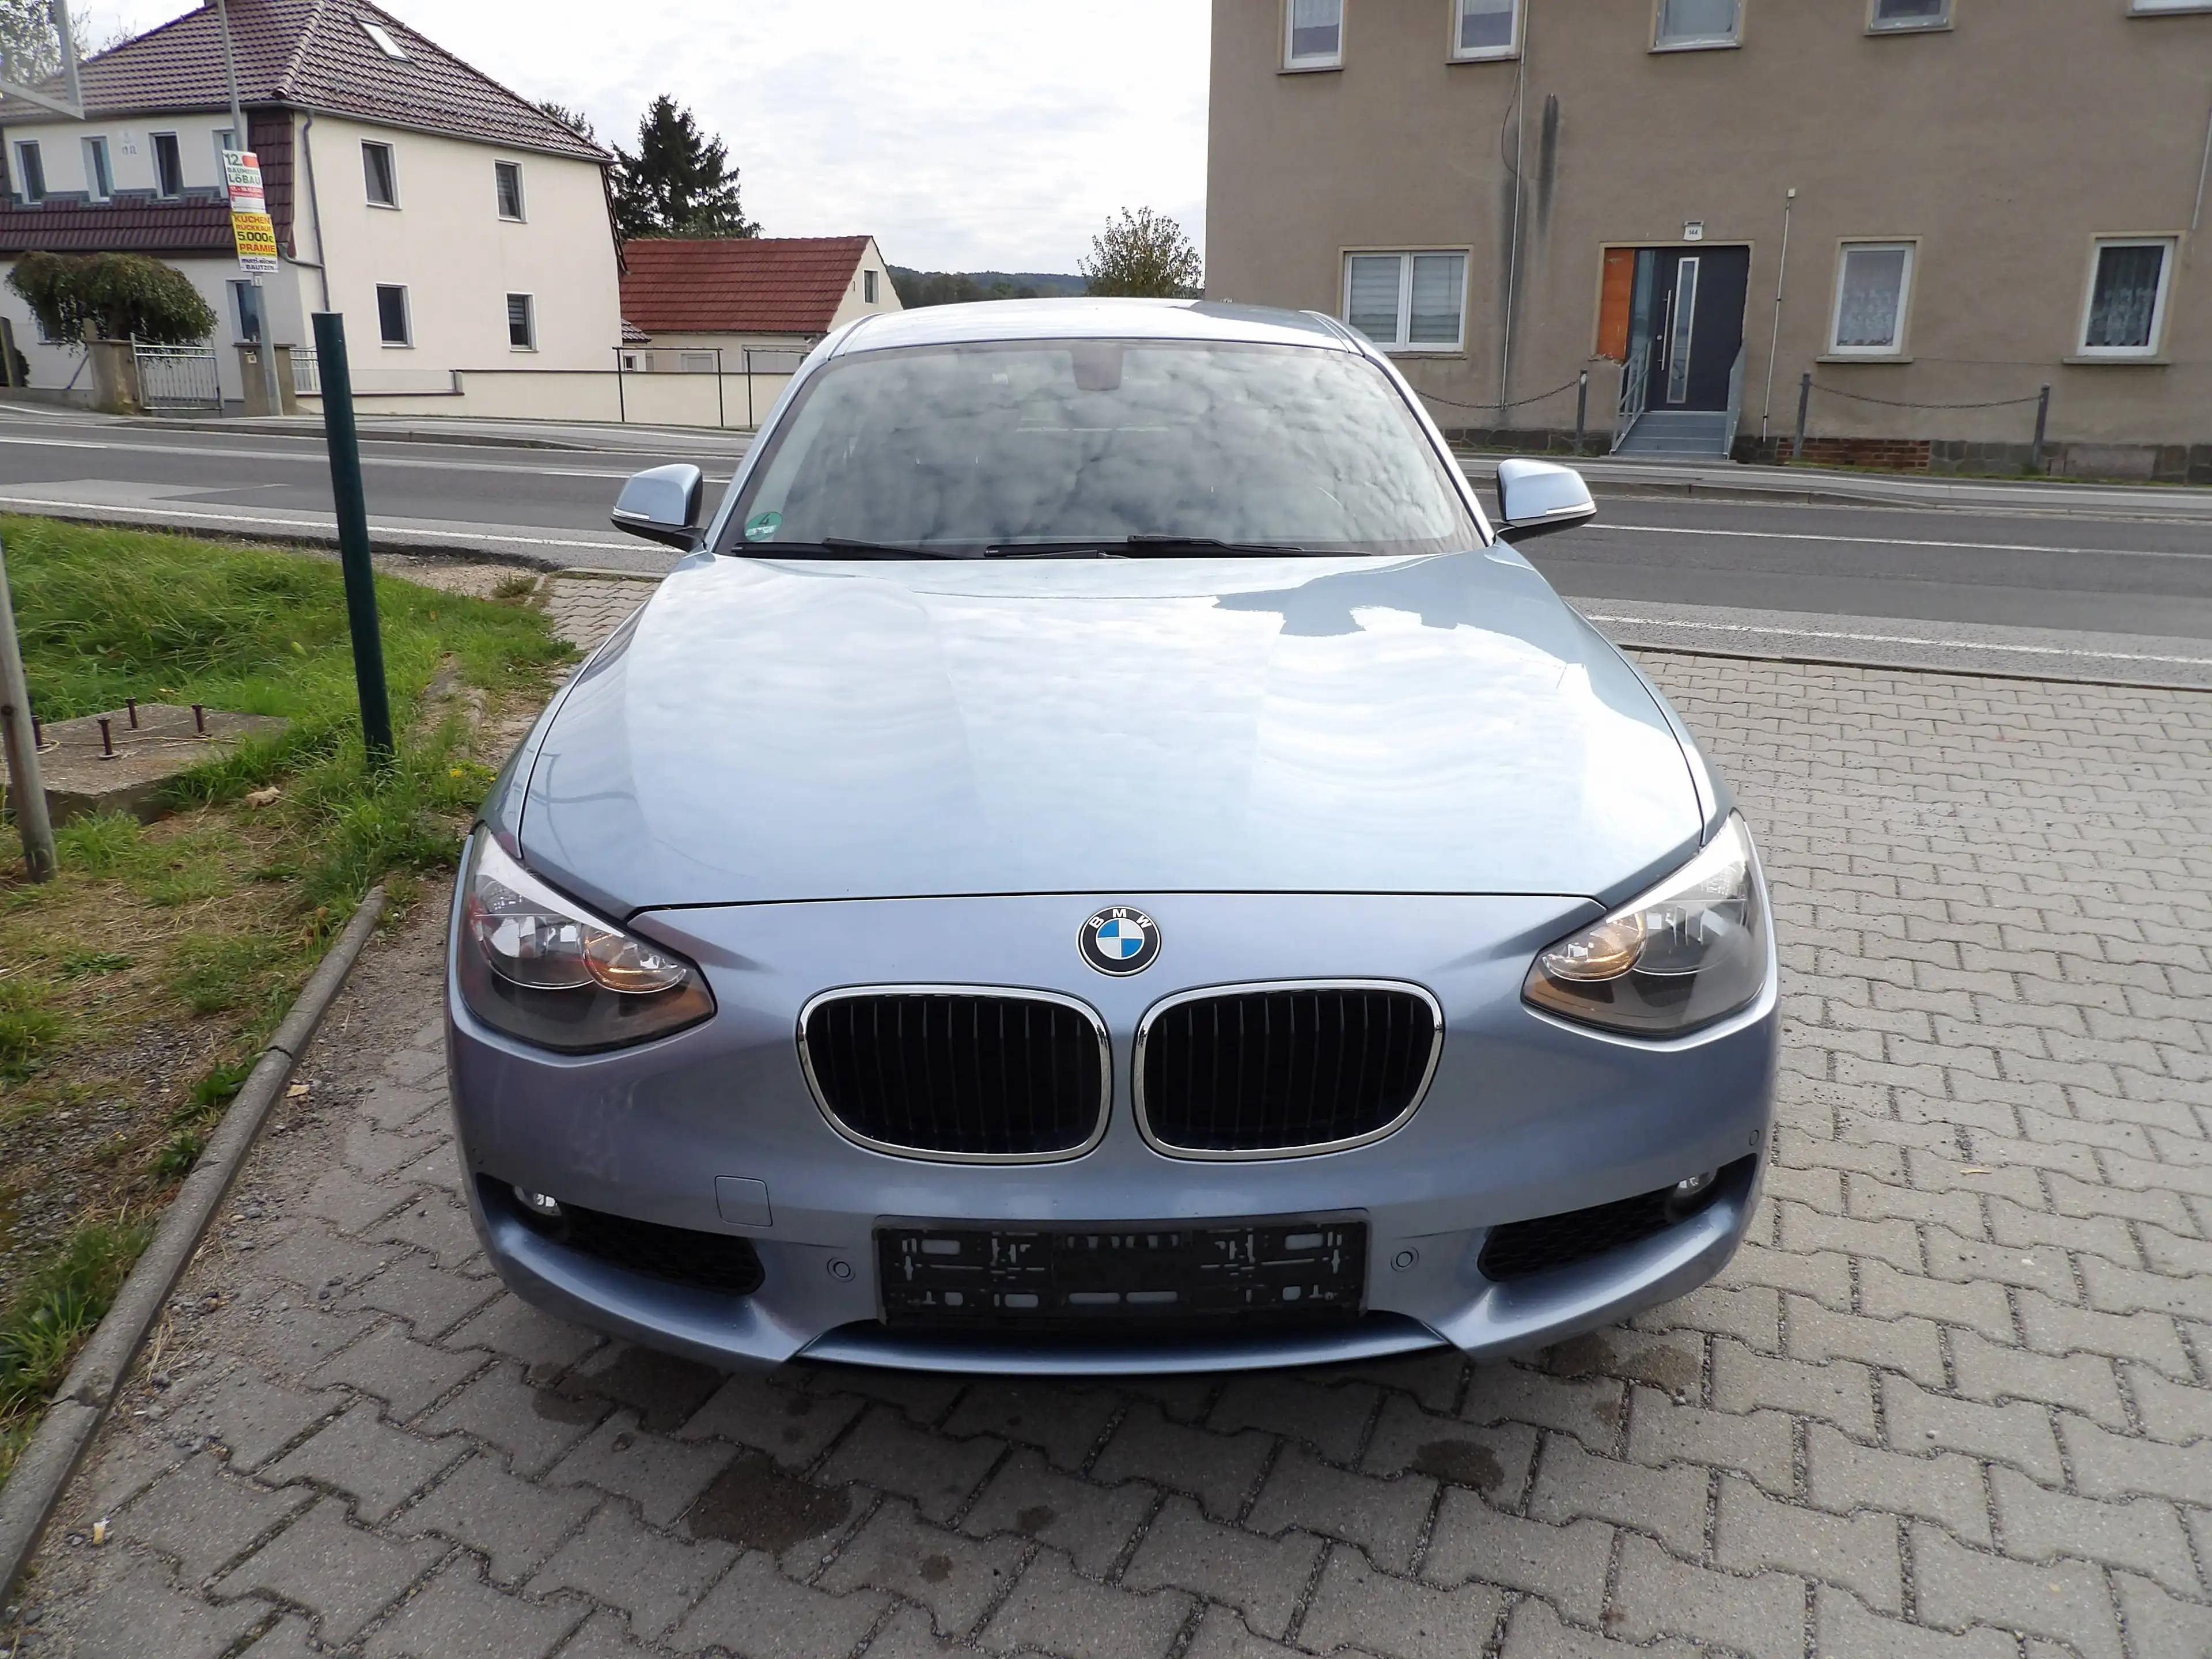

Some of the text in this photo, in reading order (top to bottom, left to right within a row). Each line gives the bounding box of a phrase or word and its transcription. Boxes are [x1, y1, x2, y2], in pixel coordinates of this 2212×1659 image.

[228, 173, 261, 184] LÖBAU
[758, 513, 771, 525] 4
[1088, 908, 1152, 929] BMW
